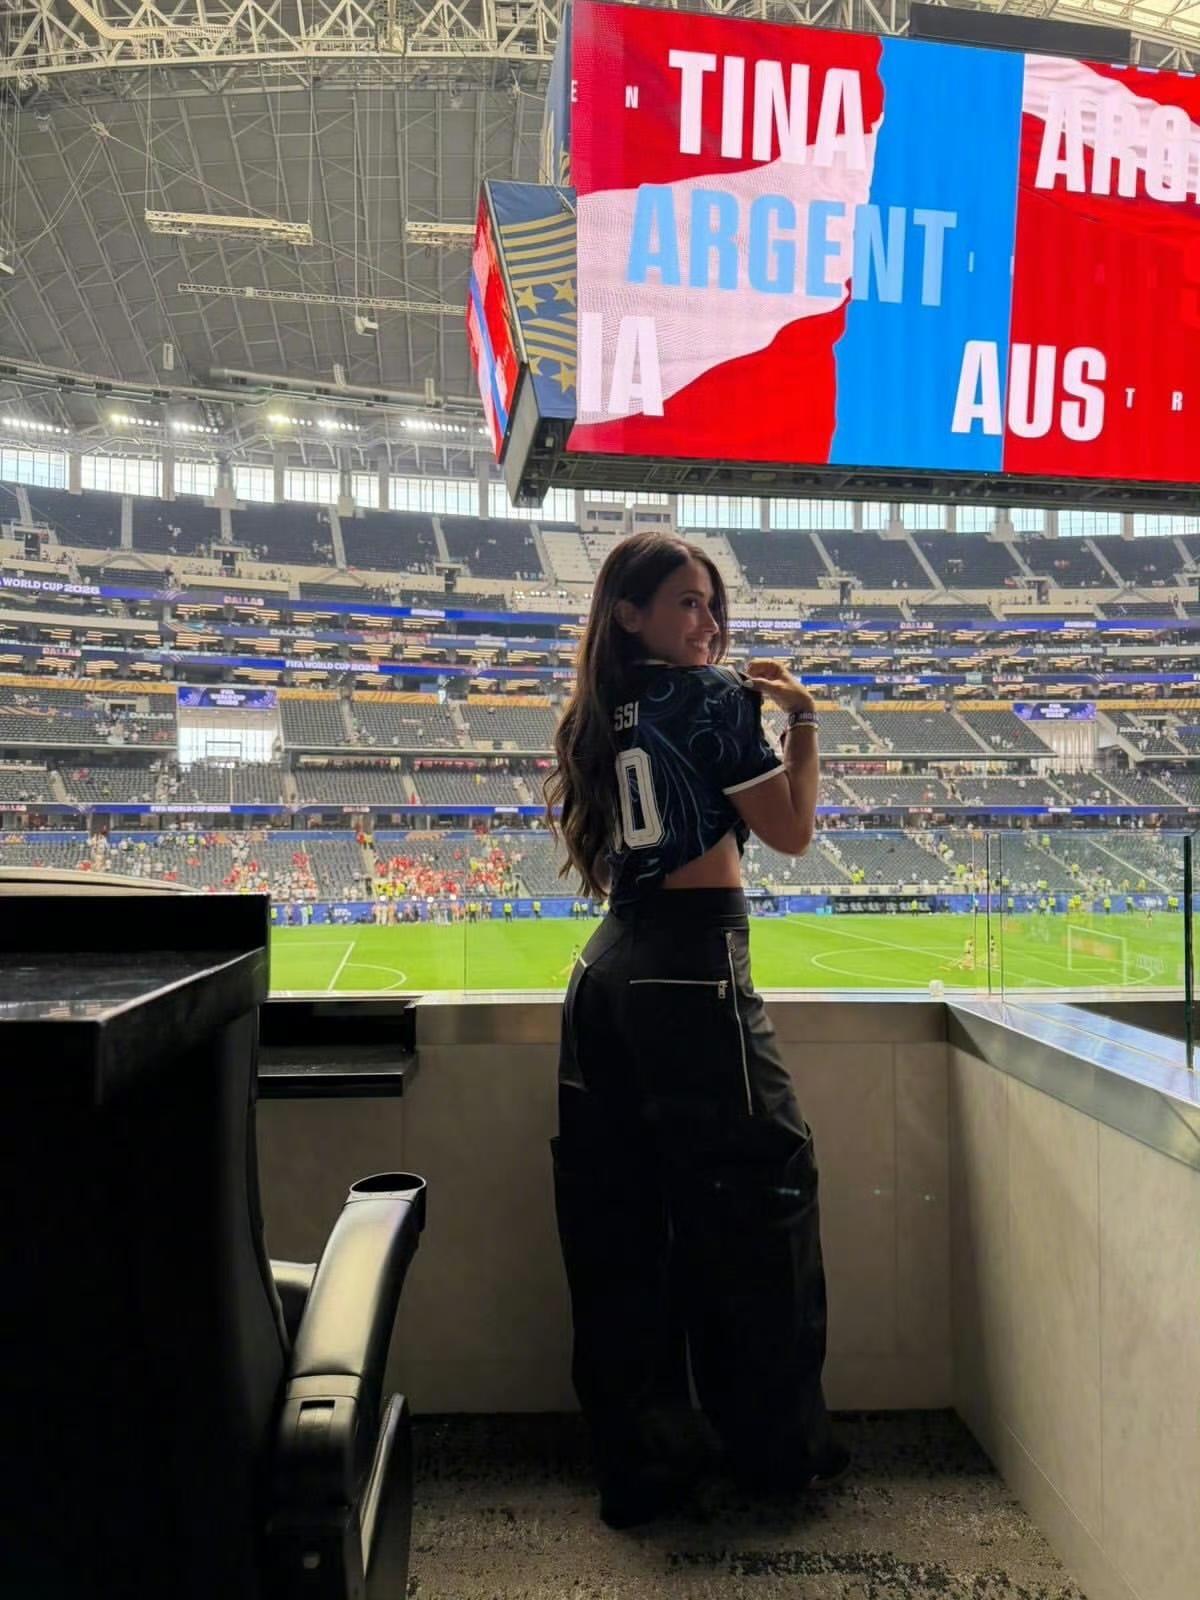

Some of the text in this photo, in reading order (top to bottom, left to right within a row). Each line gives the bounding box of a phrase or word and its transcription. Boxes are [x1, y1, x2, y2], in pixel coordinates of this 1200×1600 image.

[625, 85, 639, 109] N
[668, 49, 866, 171] TINA
[1034, 90, 1200, 206] ARG
[627, 182, 958, 307] ARGENT
[580, 311, 665, 417] IA
[950, 339, 1184, 443] AUS T R
[2, 577, 41, 590] WORLD
[42, 581, 64, 592] CUP
[42, 646, 82, 658] DALLAS
[614, 747, 666, 852] 0
